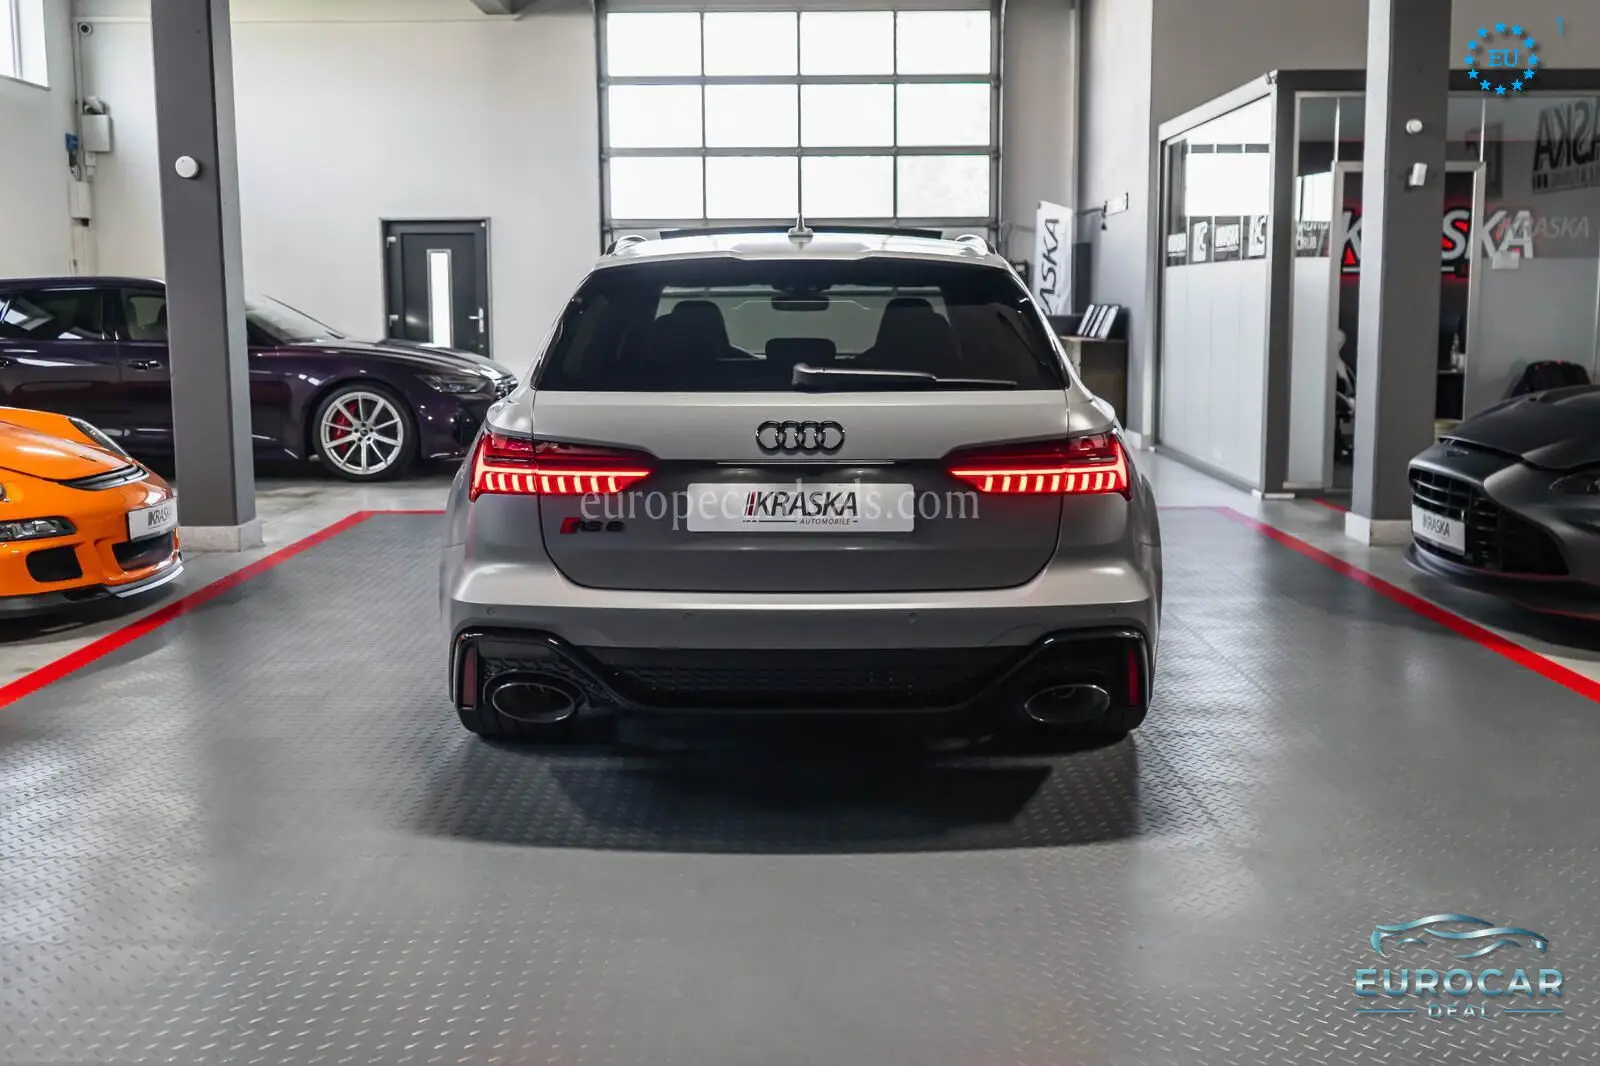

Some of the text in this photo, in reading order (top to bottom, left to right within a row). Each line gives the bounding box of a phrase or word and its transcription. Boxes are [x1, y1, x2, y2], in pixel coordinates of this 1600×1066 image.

[1340, 210, 1534, 260] KSKA
[1040, 218, 1060, 315] ASKA
[755, 491, 858, 517] KRASKA
[799, 518, 851, 526] AUTOMOBILE
